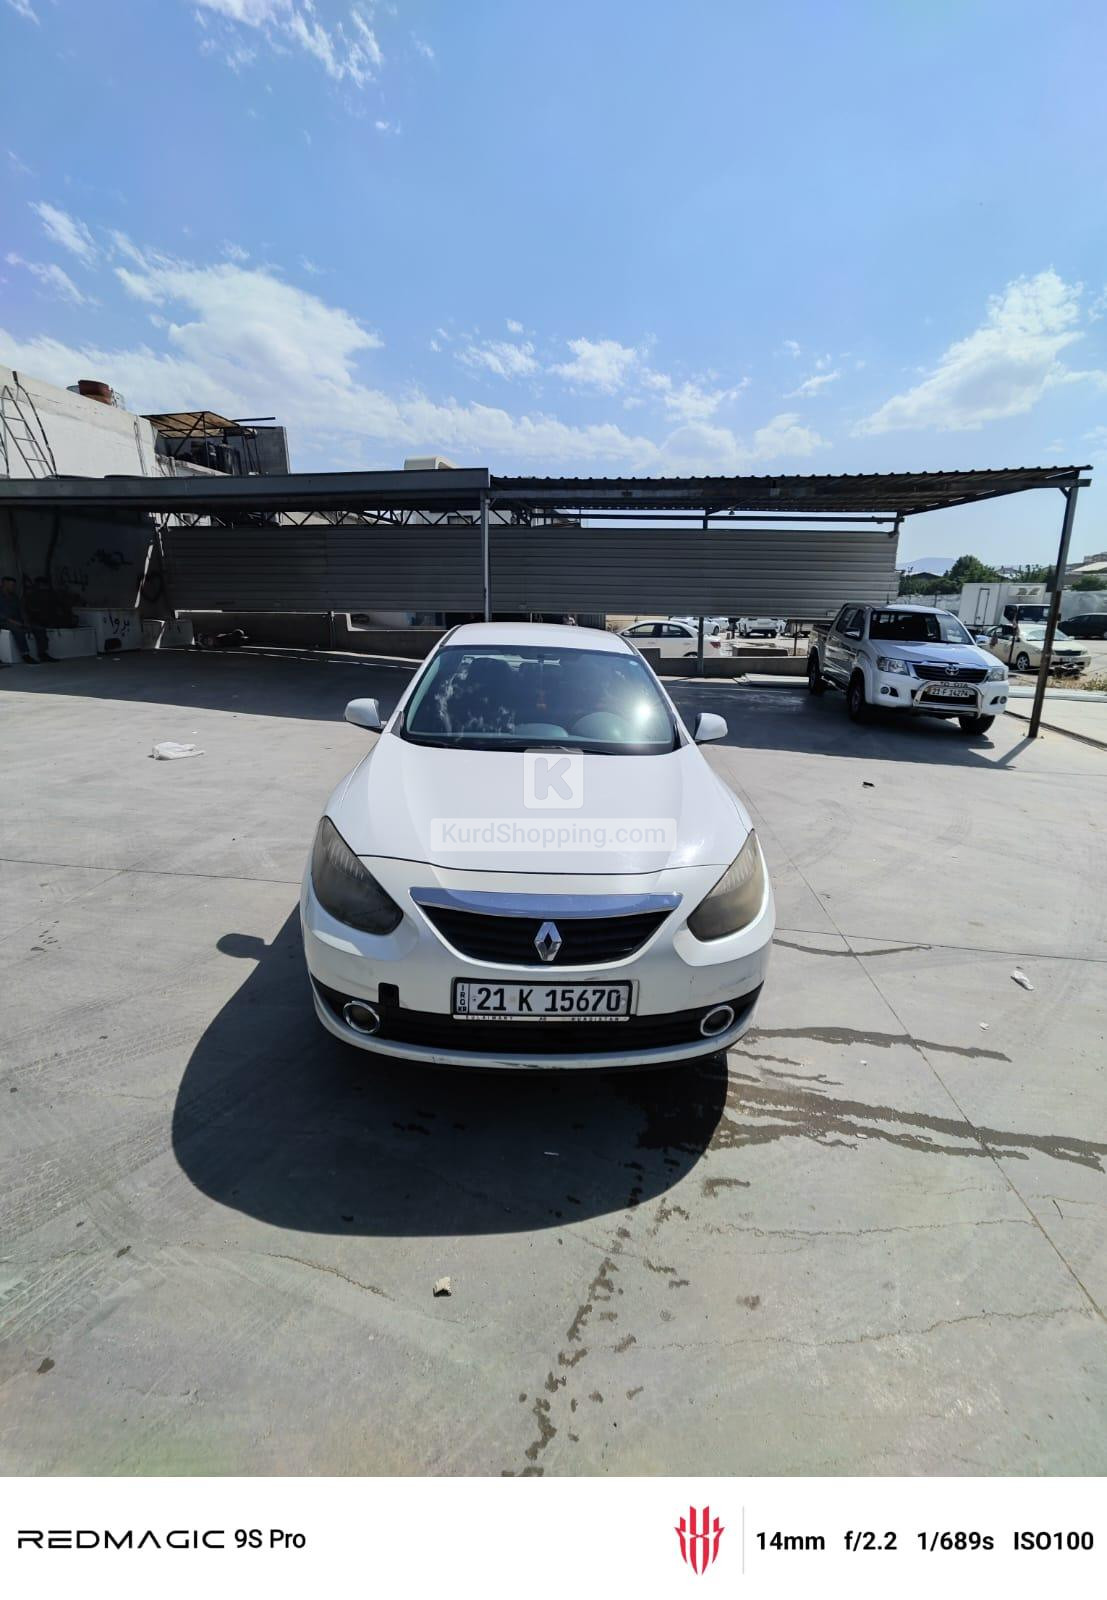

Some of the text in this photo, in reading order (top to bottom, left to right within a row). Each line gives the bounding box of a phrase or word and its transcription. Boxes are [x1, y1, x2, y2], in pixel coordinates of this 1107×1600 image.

[477, 987, 621, 1013] 21 K 15670
